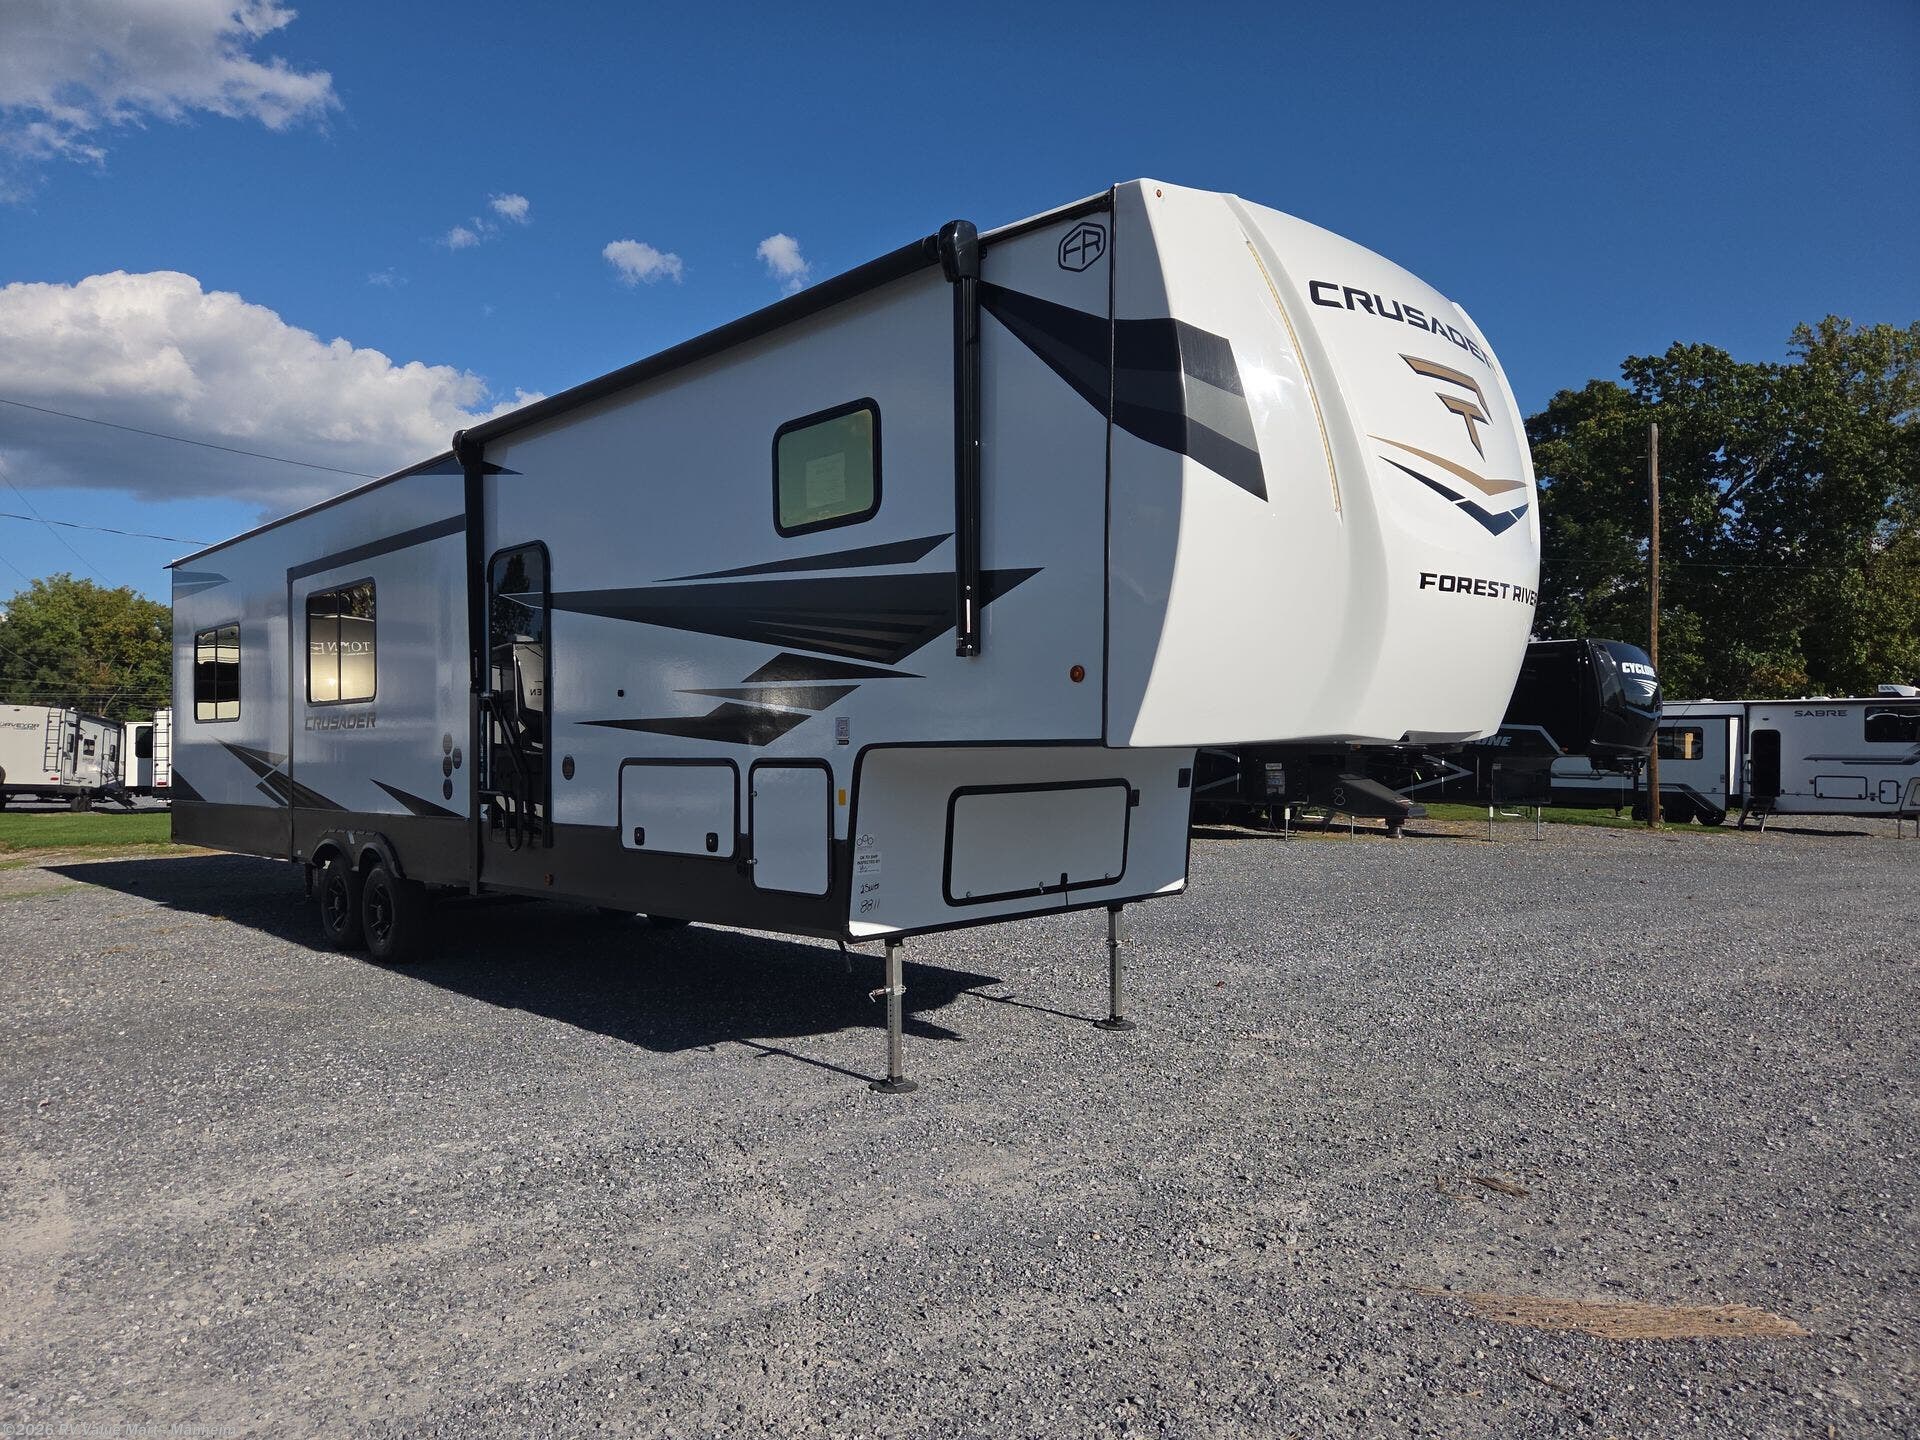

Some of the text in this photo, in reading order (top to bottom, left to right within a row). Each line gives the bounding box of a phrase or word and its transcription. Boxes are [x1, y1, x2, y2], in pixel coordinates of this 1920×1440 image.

[1308, 279, 1498, 376] CRUSADER
[1419, 572, 1510, 599] FOREST
[305, 713, 376, 731] CRUSADER
[1794, 709, 1849, 717] SABRE
